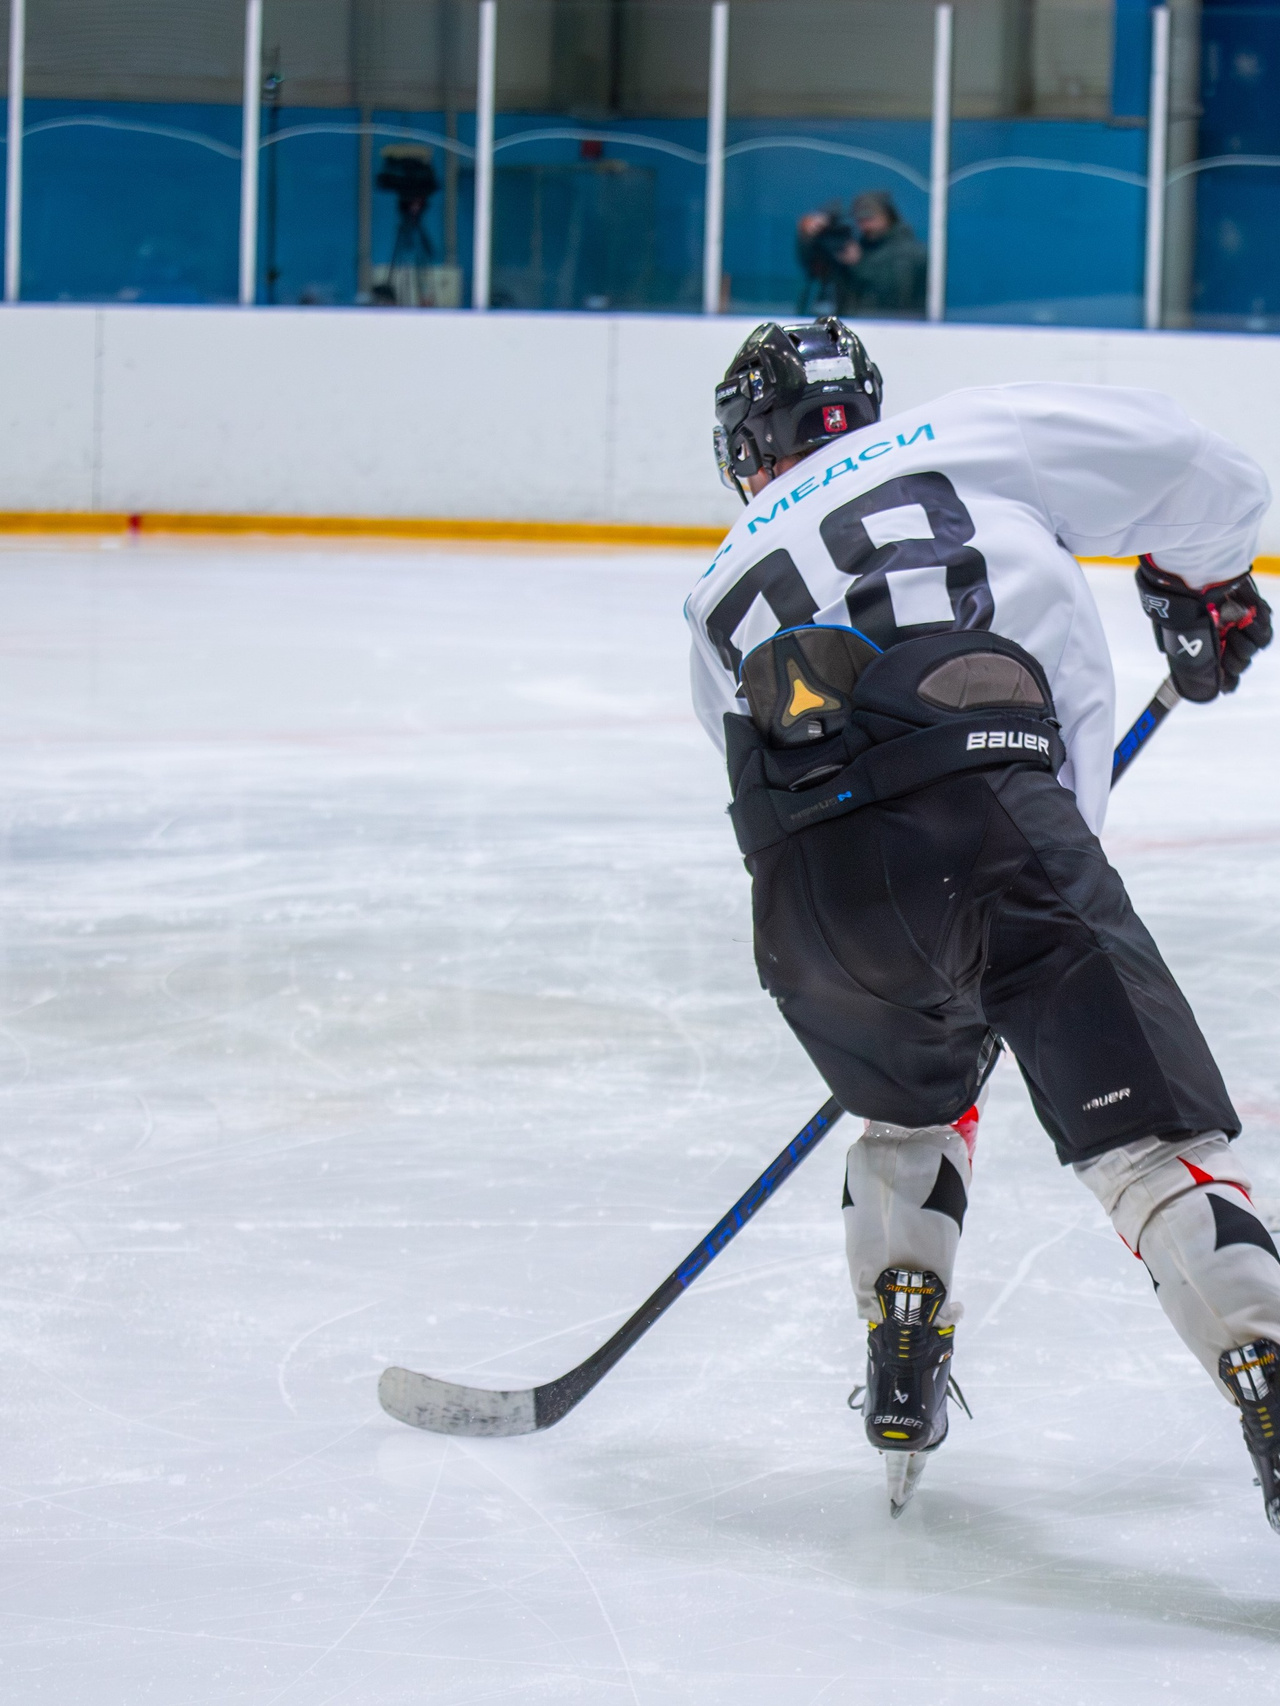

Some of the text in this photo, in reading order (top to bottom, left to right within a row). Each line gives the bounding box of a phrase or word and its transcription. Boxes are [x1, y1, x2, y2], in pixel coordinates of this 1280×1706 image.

[747, 423, 936, 535] МЕДСИ
[966, 731, 1050, 755] BAUER
[873, 1415, 924, 1429] BAUER
